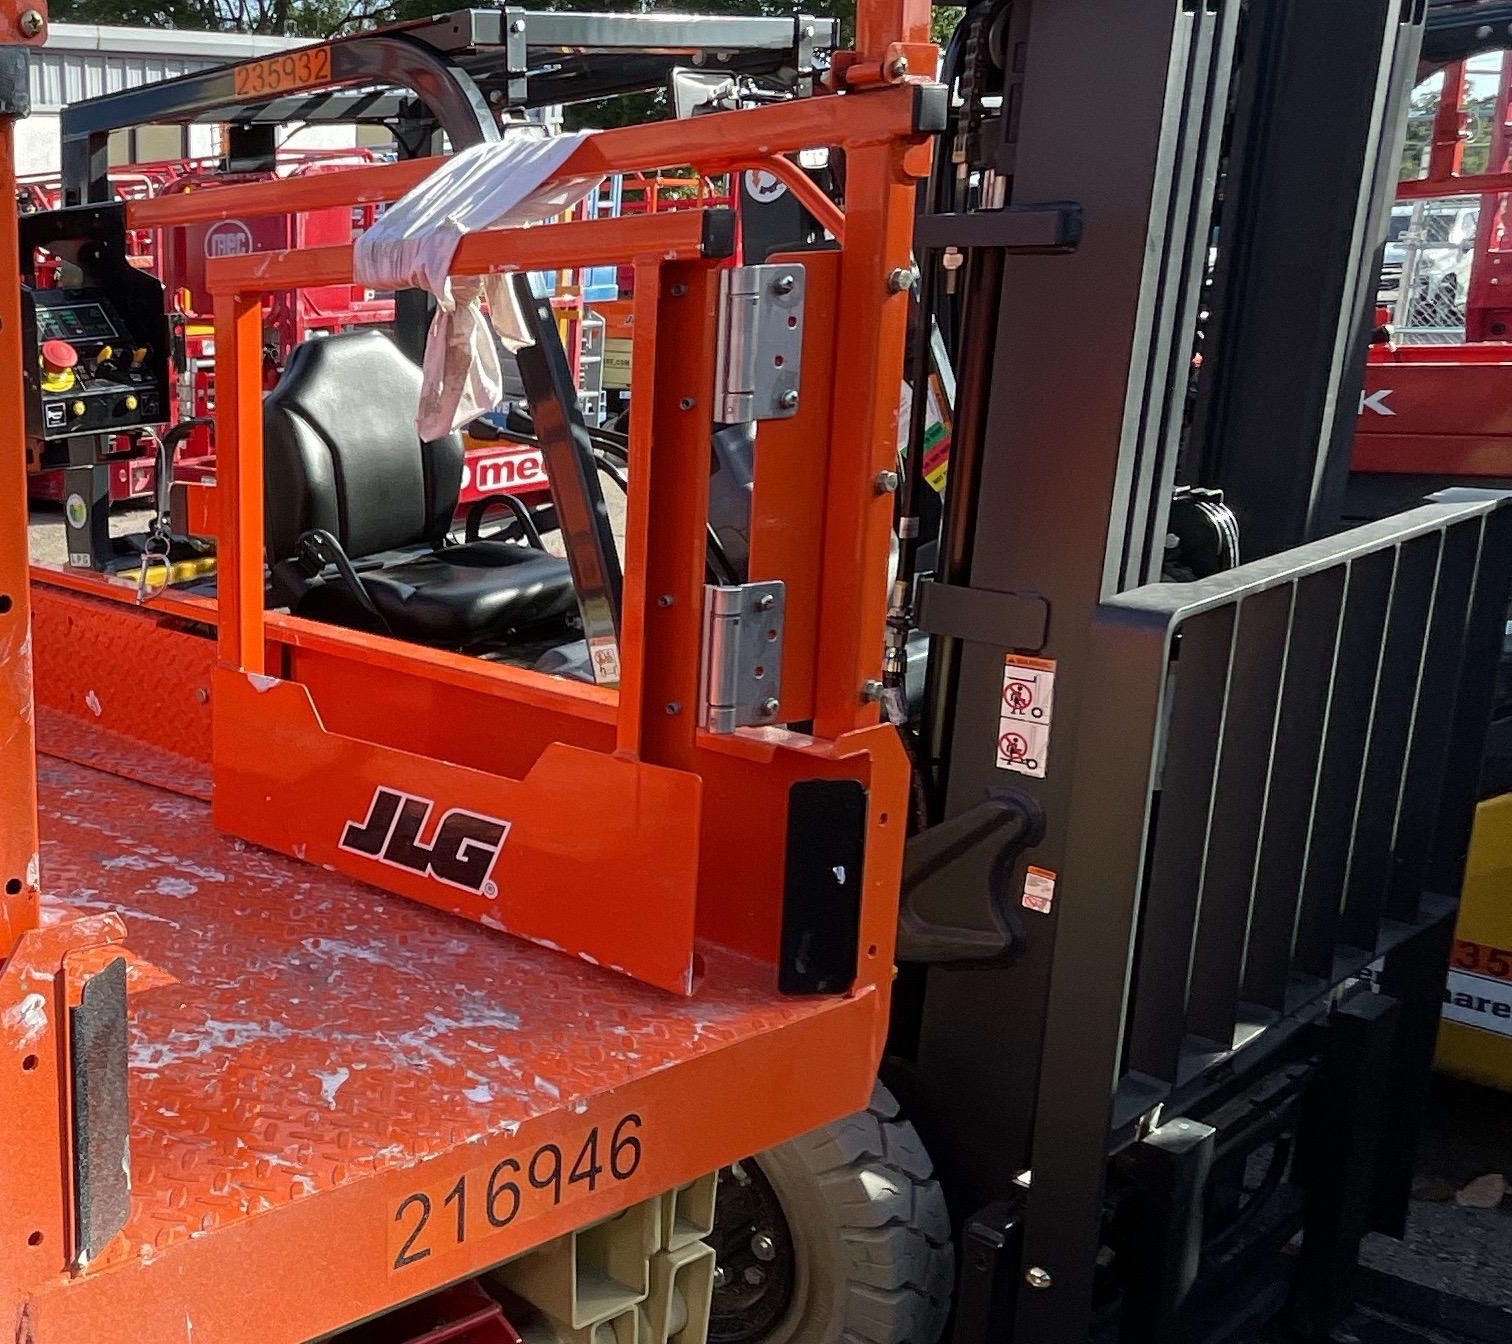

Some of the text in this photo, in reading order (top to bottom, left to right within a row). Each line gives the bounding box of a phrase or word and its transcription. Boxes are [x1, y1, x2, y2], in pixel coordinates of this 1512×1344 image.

[236, 48, 330, 96] 235932
[338, 784, 512, 897] JLG
[393, 1112, 643, 1270] 216946
